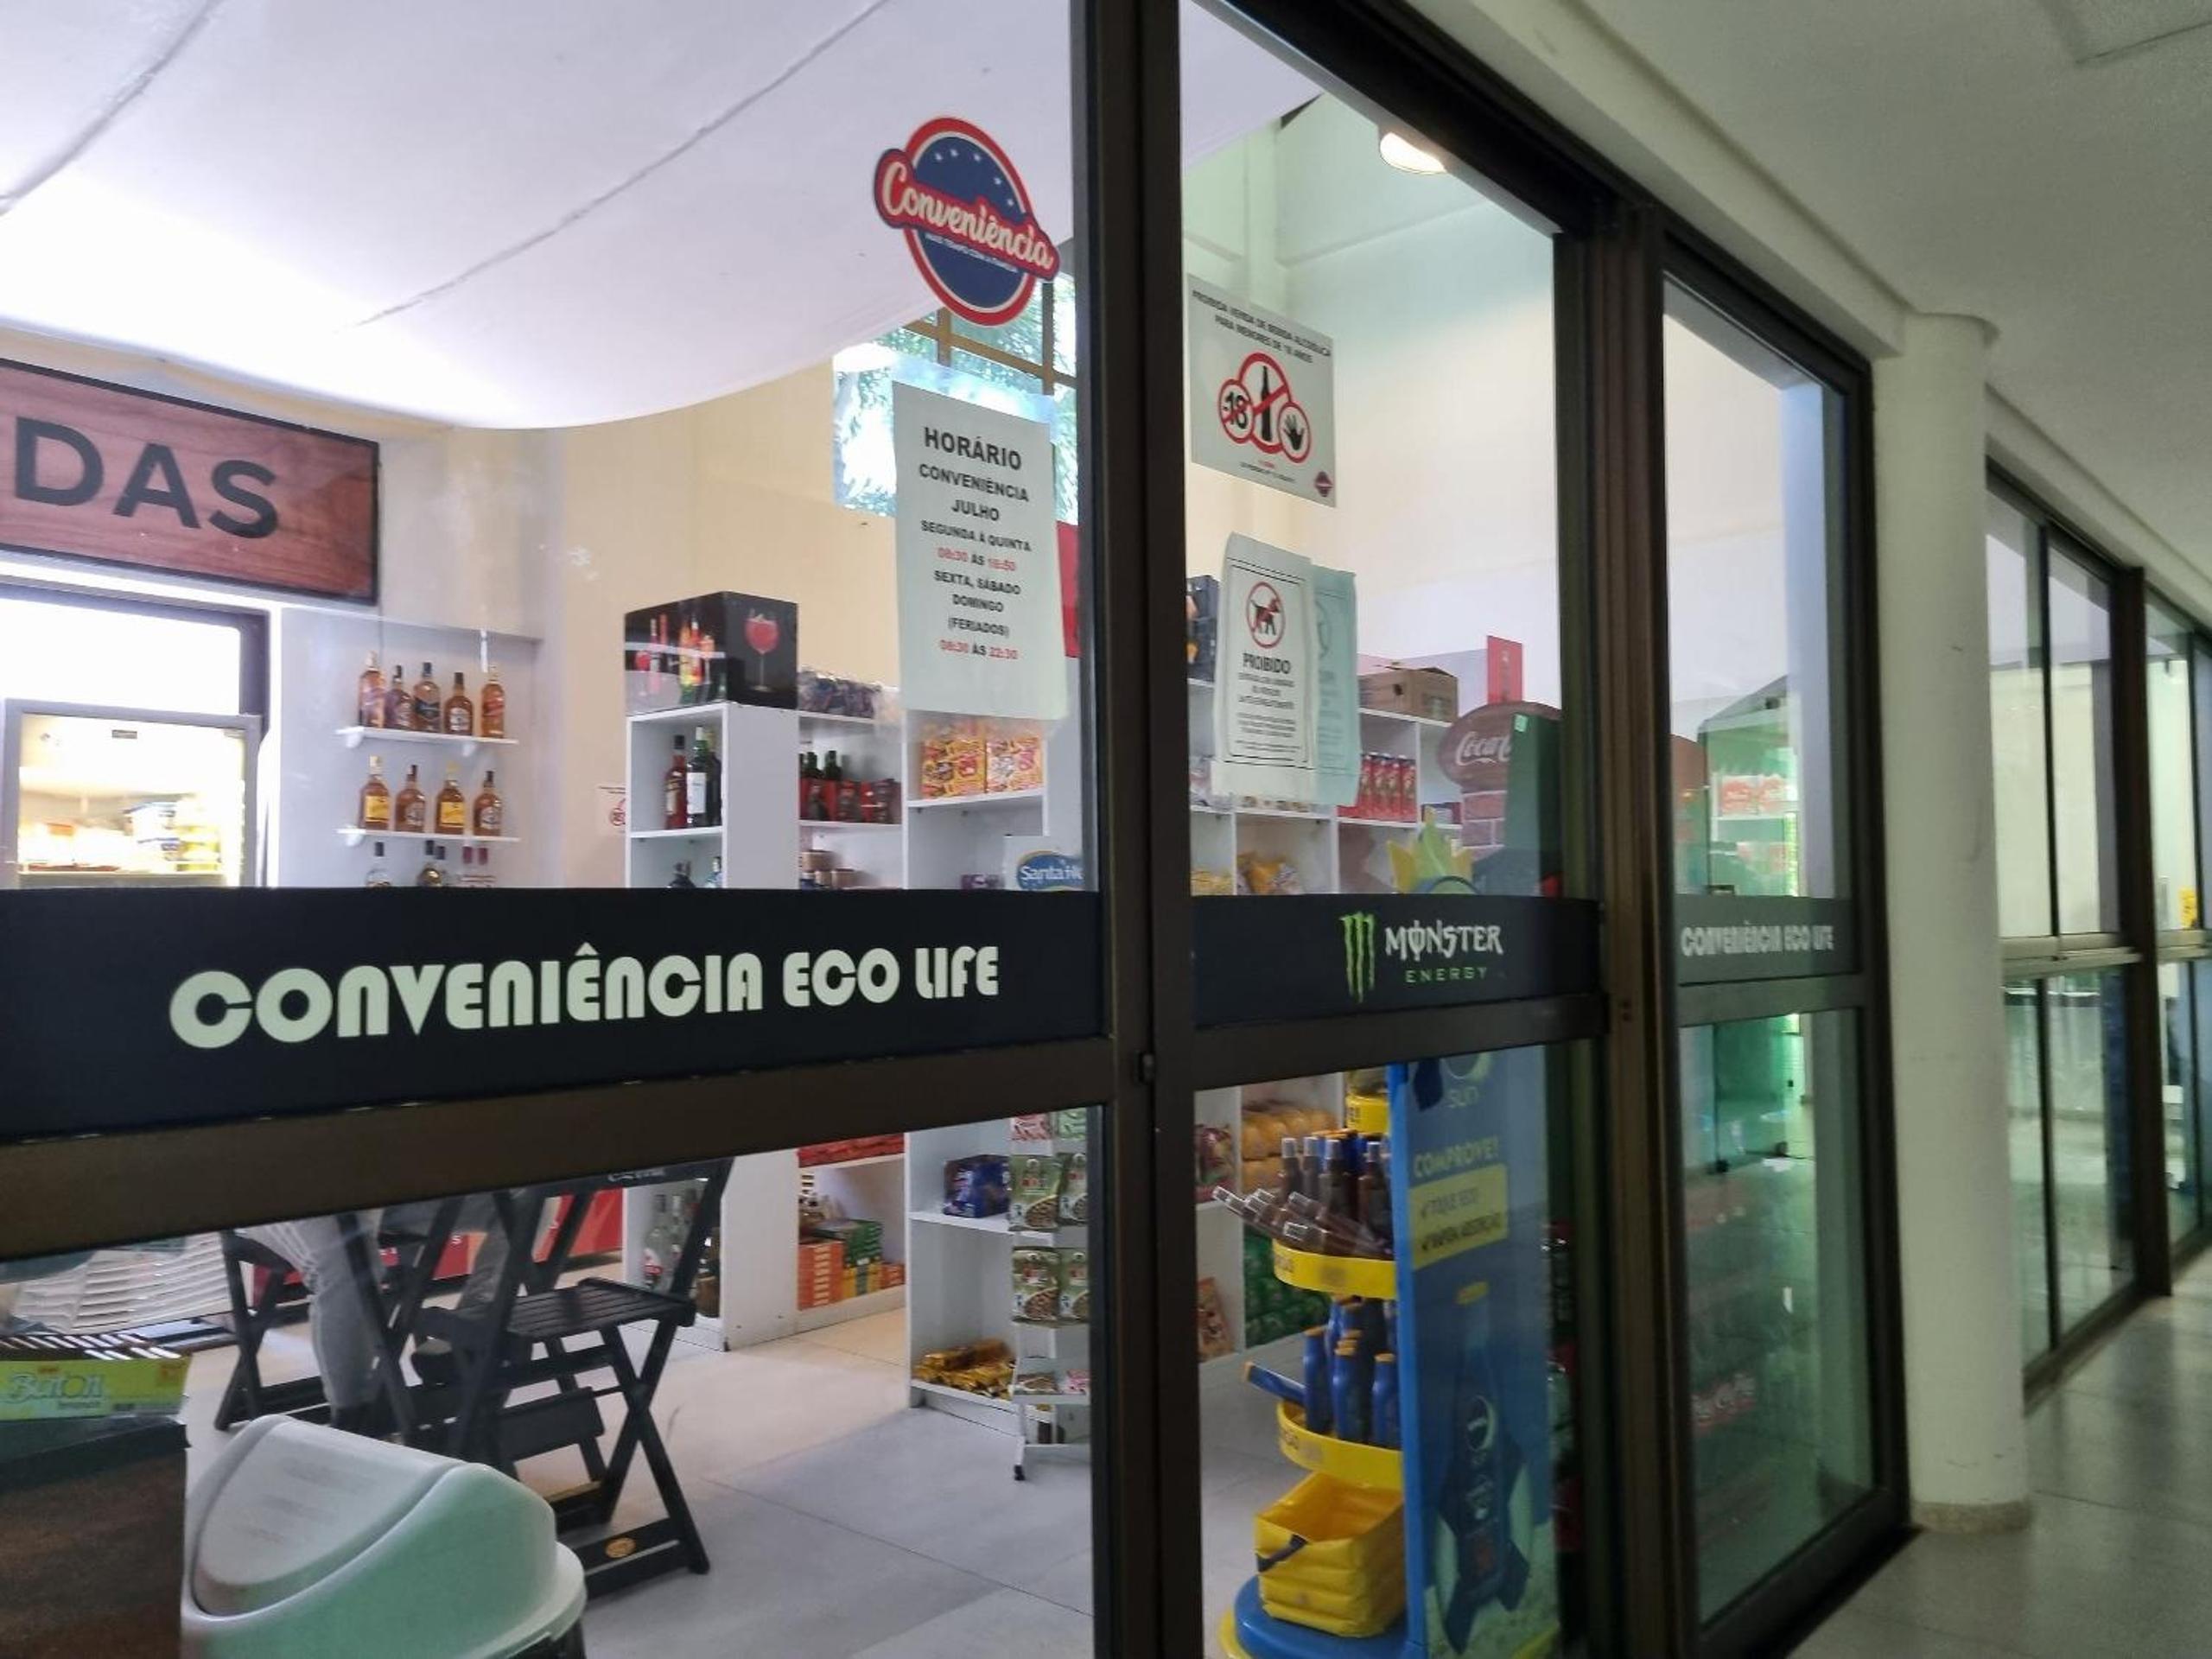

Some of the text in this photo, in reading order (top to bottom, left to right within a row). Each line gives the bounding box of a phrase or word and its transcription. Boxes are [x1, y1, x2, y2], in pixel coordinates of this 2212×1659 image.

[881, 161, 1056, 270] Conveniência
[924, 426, 1022, 471] HORÁRIO
[918, 463, 1029, 502] CONVENIÊNCIA
[951, 499, 999, 521] JULHO
[921, 519, 975, 541] SEGUNDA
[988, 534, 1032, 552] QUINTA
[934, 569, 974, 588] SEXTA,
[952, 594, 1005, 613] DOMINGO
[948, 617, 1010, 639] (FERIADOS)
[1243, 652, 1292, 675] PROIBIDO
[1385, 919, 1504, 962] MONSTER
[1405, 966, 1487, 983] ENERGY
[169, 943, 999, 1049] CONVENIÊNCIA ECO LIFE
